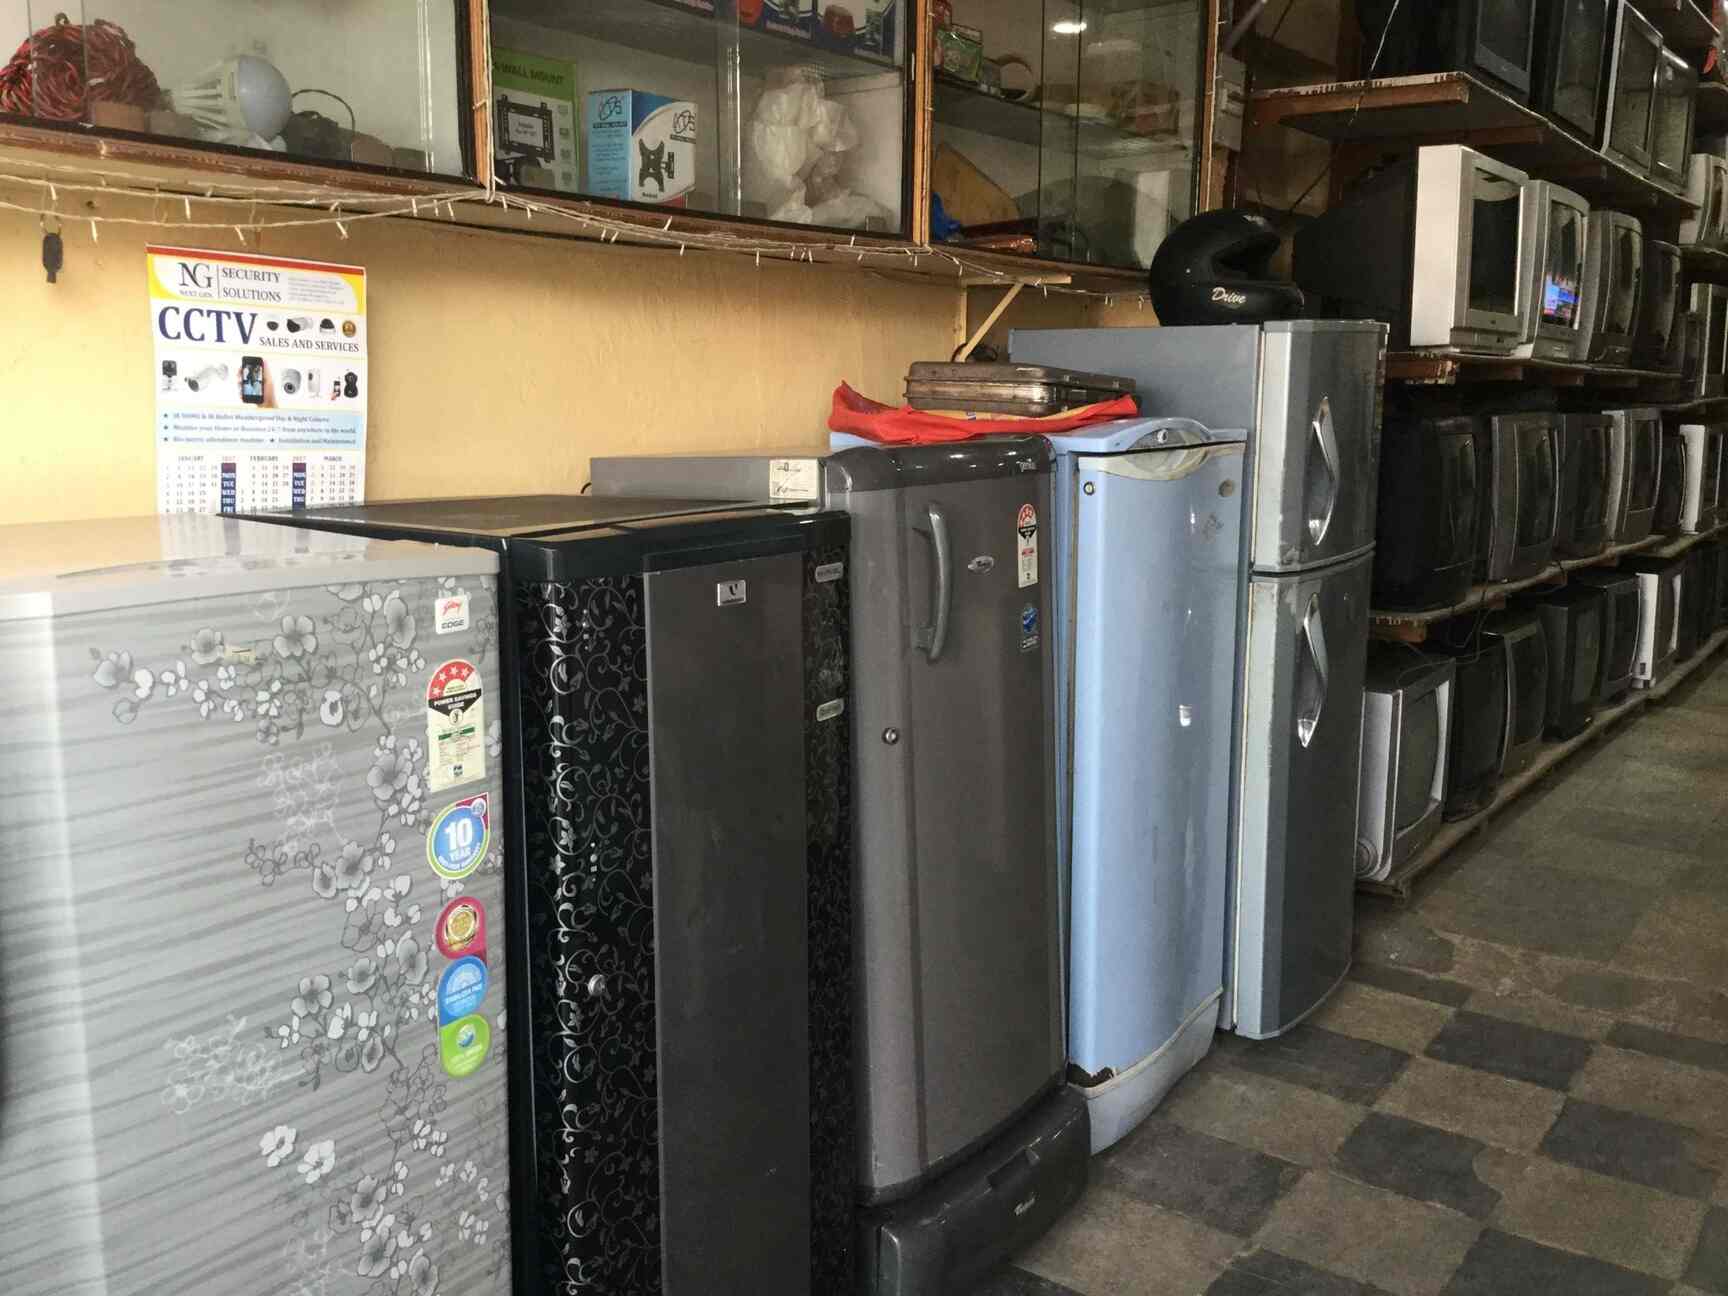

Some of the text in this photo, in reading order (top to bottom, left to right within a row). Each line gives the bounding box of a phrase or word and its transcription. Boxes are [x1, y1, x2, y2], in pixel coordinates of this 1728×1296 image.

[177, 262, 213, 288] NG
[222, 267, 281, 283] SECURITY
[222, 286, 282, 301] SOLUTIONS
[1212, 286, 1246, 303] Drive
[158, 306, 258, 345] CCTV
[259, 337, 360, 353] SALES AND SERVICES
[441, 618, 465, 630] EDGE
[445, 817, 473, 850] 10
